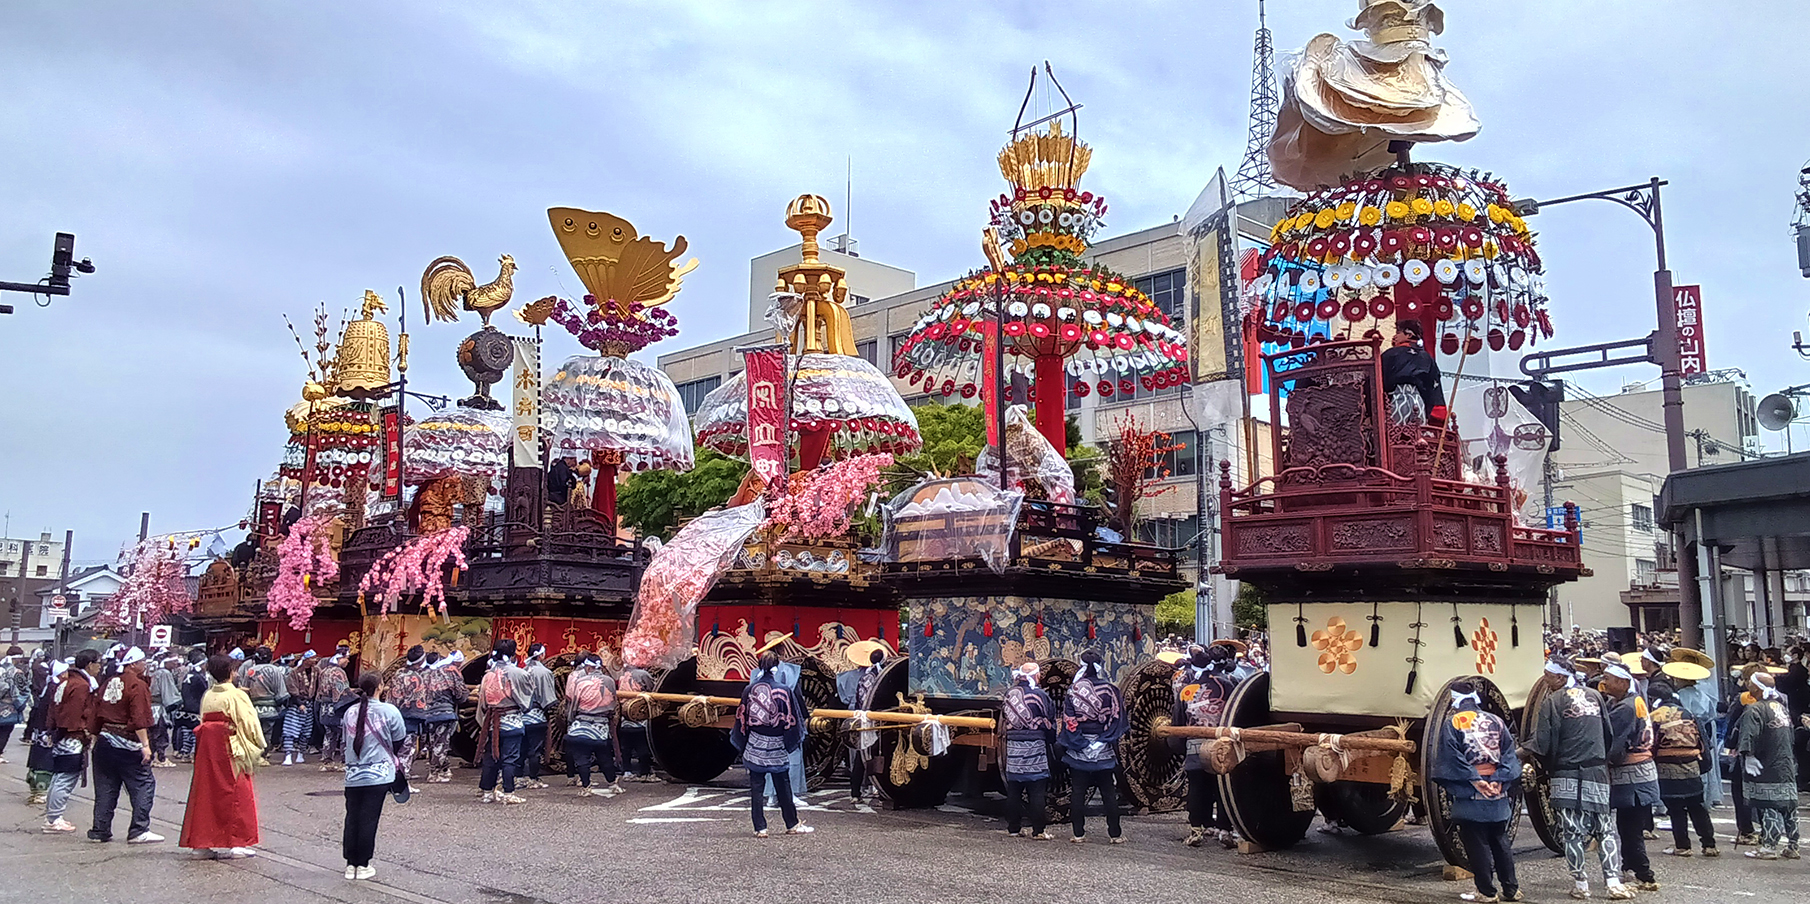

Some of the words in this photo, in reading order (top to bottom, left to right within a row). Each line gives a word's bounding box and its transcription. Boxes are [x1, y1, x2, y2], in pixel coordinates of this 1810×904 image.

[1675, 290, 1700, 374] 仏壇の山内
